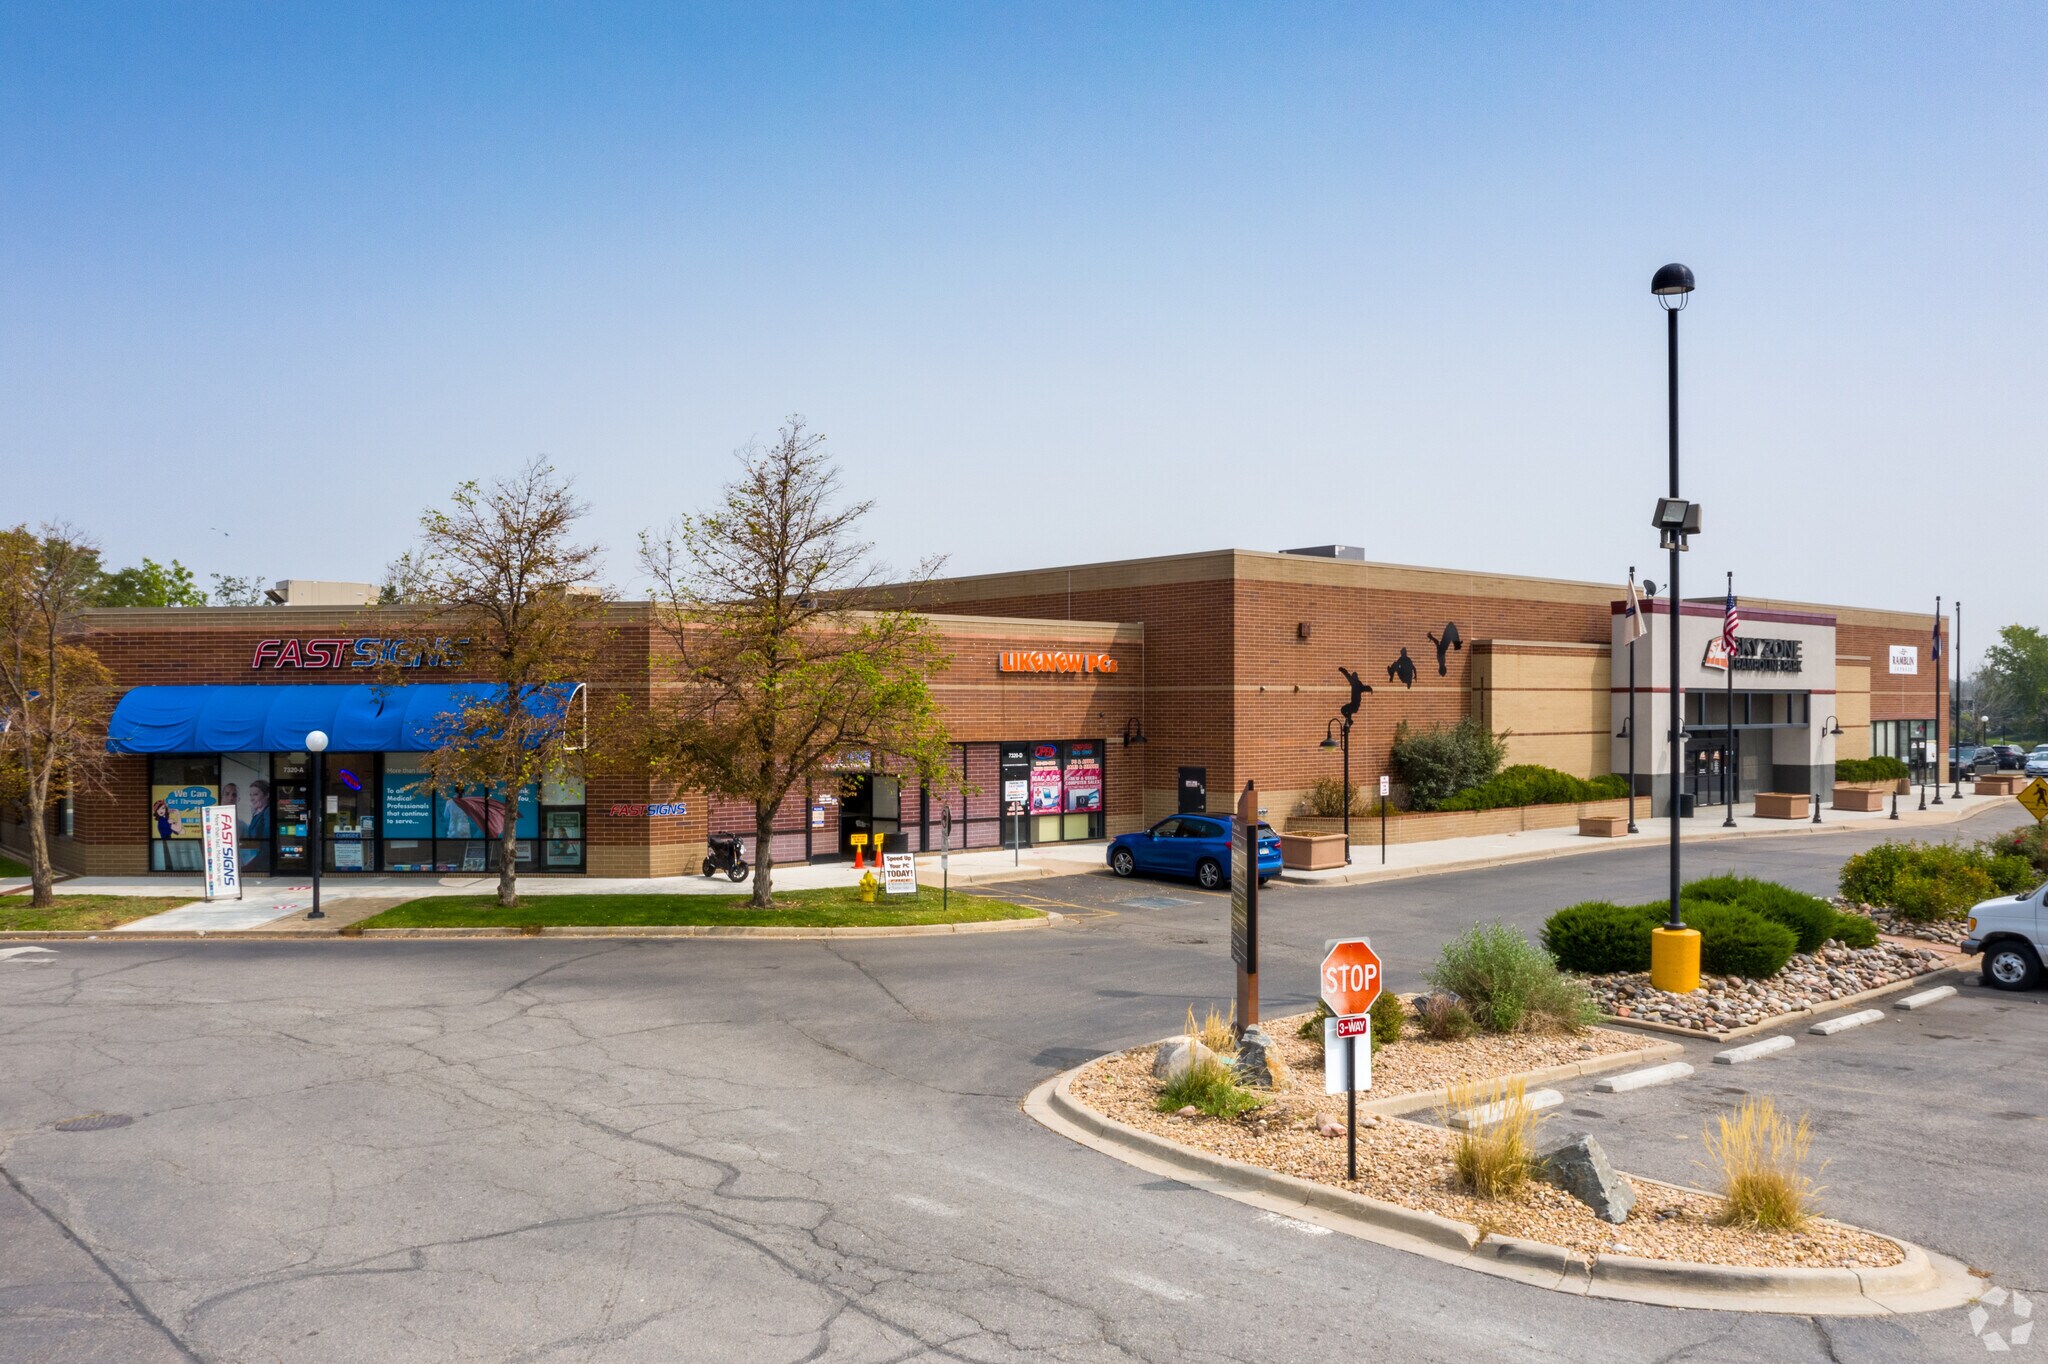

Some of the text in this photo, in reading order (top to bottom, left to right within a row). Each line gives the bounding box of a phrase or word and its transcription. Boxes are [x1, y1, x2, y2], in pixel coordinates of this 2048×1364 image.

[1763, 638, 1803, 659] ZONE
[1782, 660, 1803, 673] PARK
[1035, 745, 1055, 758] OPEN
[174, 790, 207, 798] We Can
[610, 803, 686, 817] FASTSIGNS
[221, 814, 235, 886] FASTSIGNS
[886, 869, 913, 878] TODAY!
[1325, 963, 1377, 994] STOP
[1338, 1021, 1366, 1034] 3-WAY
